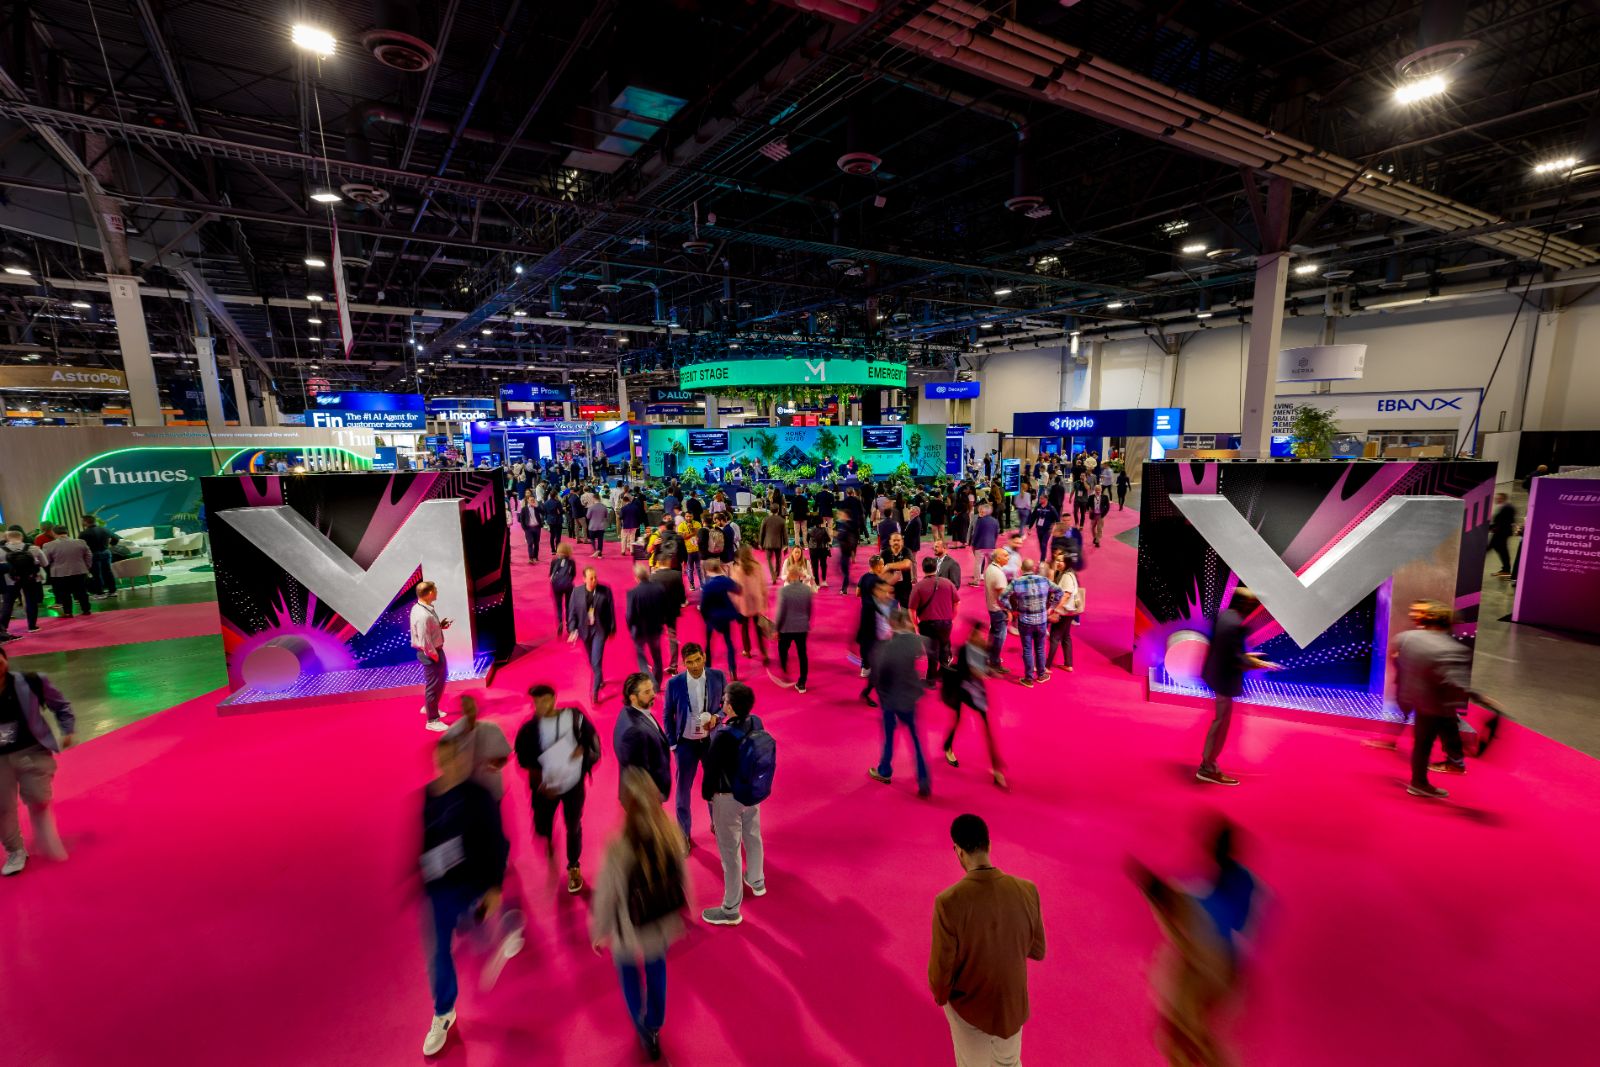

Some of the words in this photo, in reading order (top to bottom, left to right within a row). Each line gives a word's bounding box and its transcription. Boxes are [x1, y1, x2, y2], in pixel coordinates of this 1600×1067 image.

[51, 370, 121, 386] AstroPay
[699, 367, 729, 381] STAGE
[667, 391, 693, 399] ALLOY
[1377, 397, 1464, 412] EBANX
[312, 412, 344, 428] Fin
[345, 412, 362, 421] The
[362, 412, 372, 421] #1
[373, 412, 382, 421] AI
[383, 412, 405, 422] Agent
[406, 412, 419, 421] for
[449, 410, 487, 421] Incode
[346, 420, 384, 428] customer
[385, 420, 413, 428] service
[1061, 416, 1094, 431] ripple
[1548, 523, 1574, 531] Your
[1547, 532, 1588, 540] partner
[1546, 538, 1592, 548] financial
